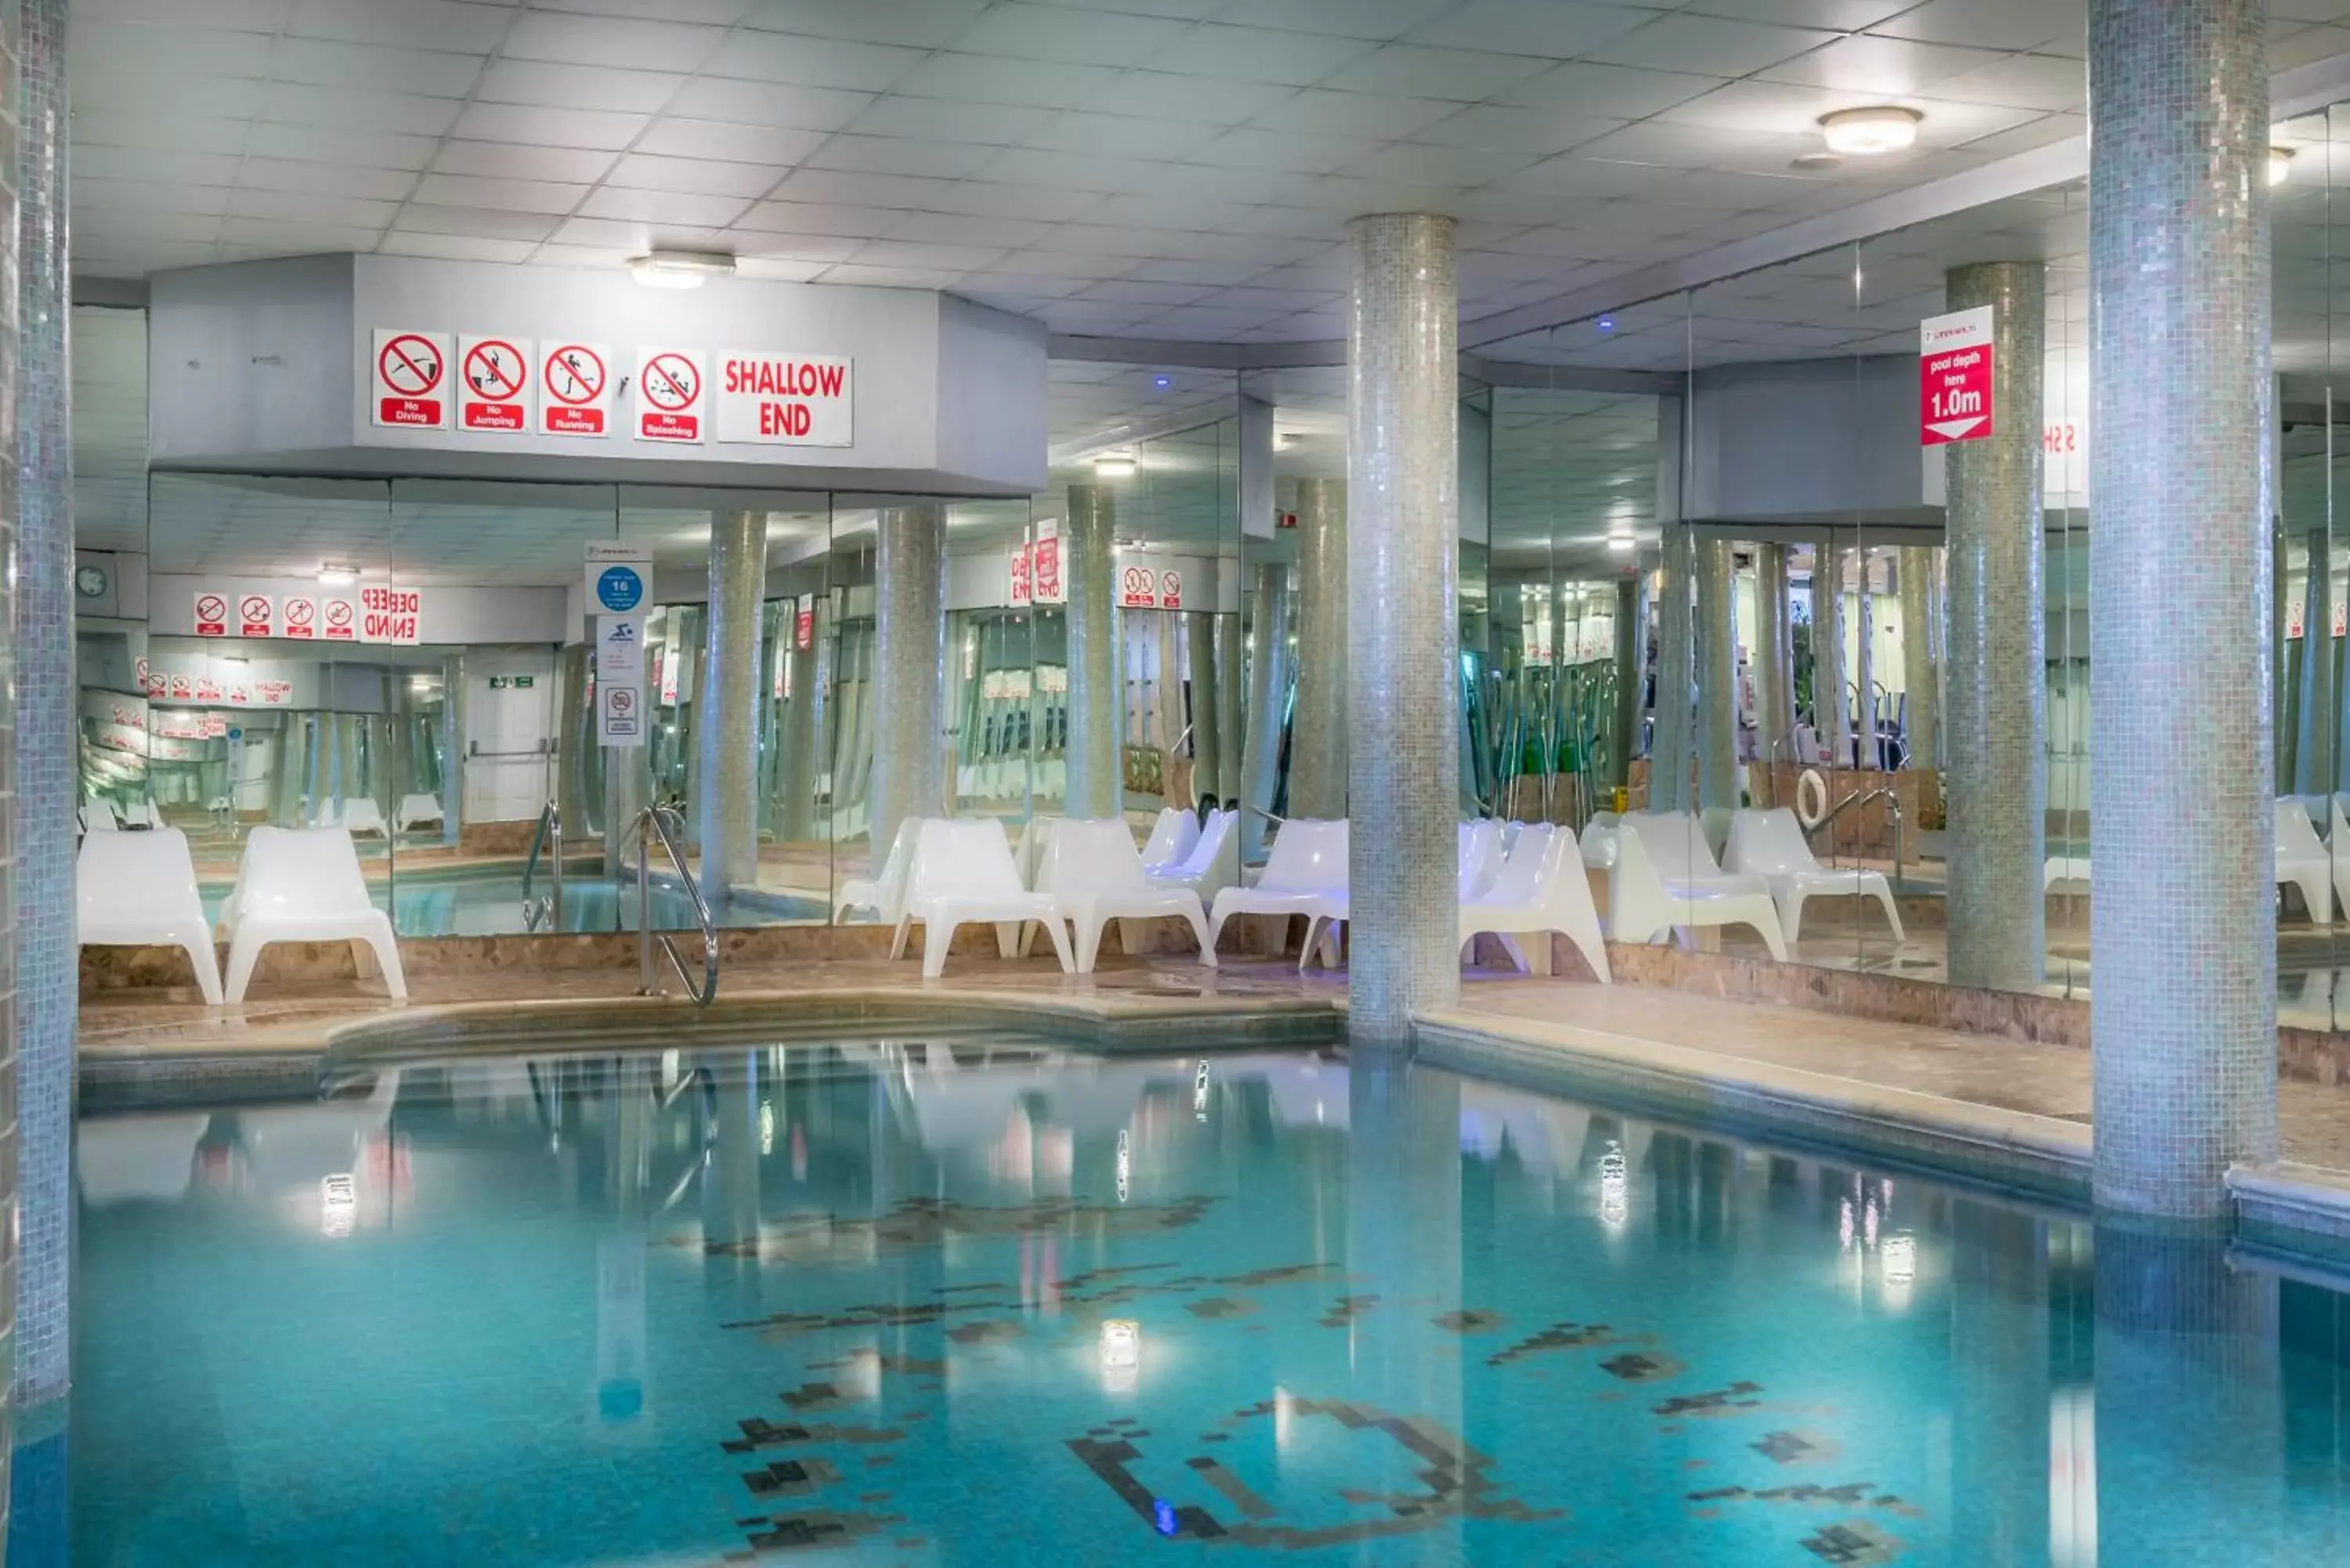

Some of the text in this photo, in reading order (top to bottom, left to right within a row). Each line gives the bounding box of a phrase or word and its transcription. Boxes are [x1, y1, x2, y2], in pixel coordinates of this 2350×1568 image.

[1931, 351, 1980, 374] pool depth
[725, 359, 844, 398] SHALLOW
[1944, 374, 1965, 387] here
[404, 401, 419, 411] No
[1931, 388, 1981, 417] 1.0m
[486, 405, 501, 415] No
[568, 409, 582, 419] No
[396, 410, 427, 423] Diving
[473, 415, 515, 427] Jumping
[663, 415, 677, 425] No
[760, 402, 811, 435] END
[555, 419, 594, 431] Running
[646, 425, 692, 437] Splashing
